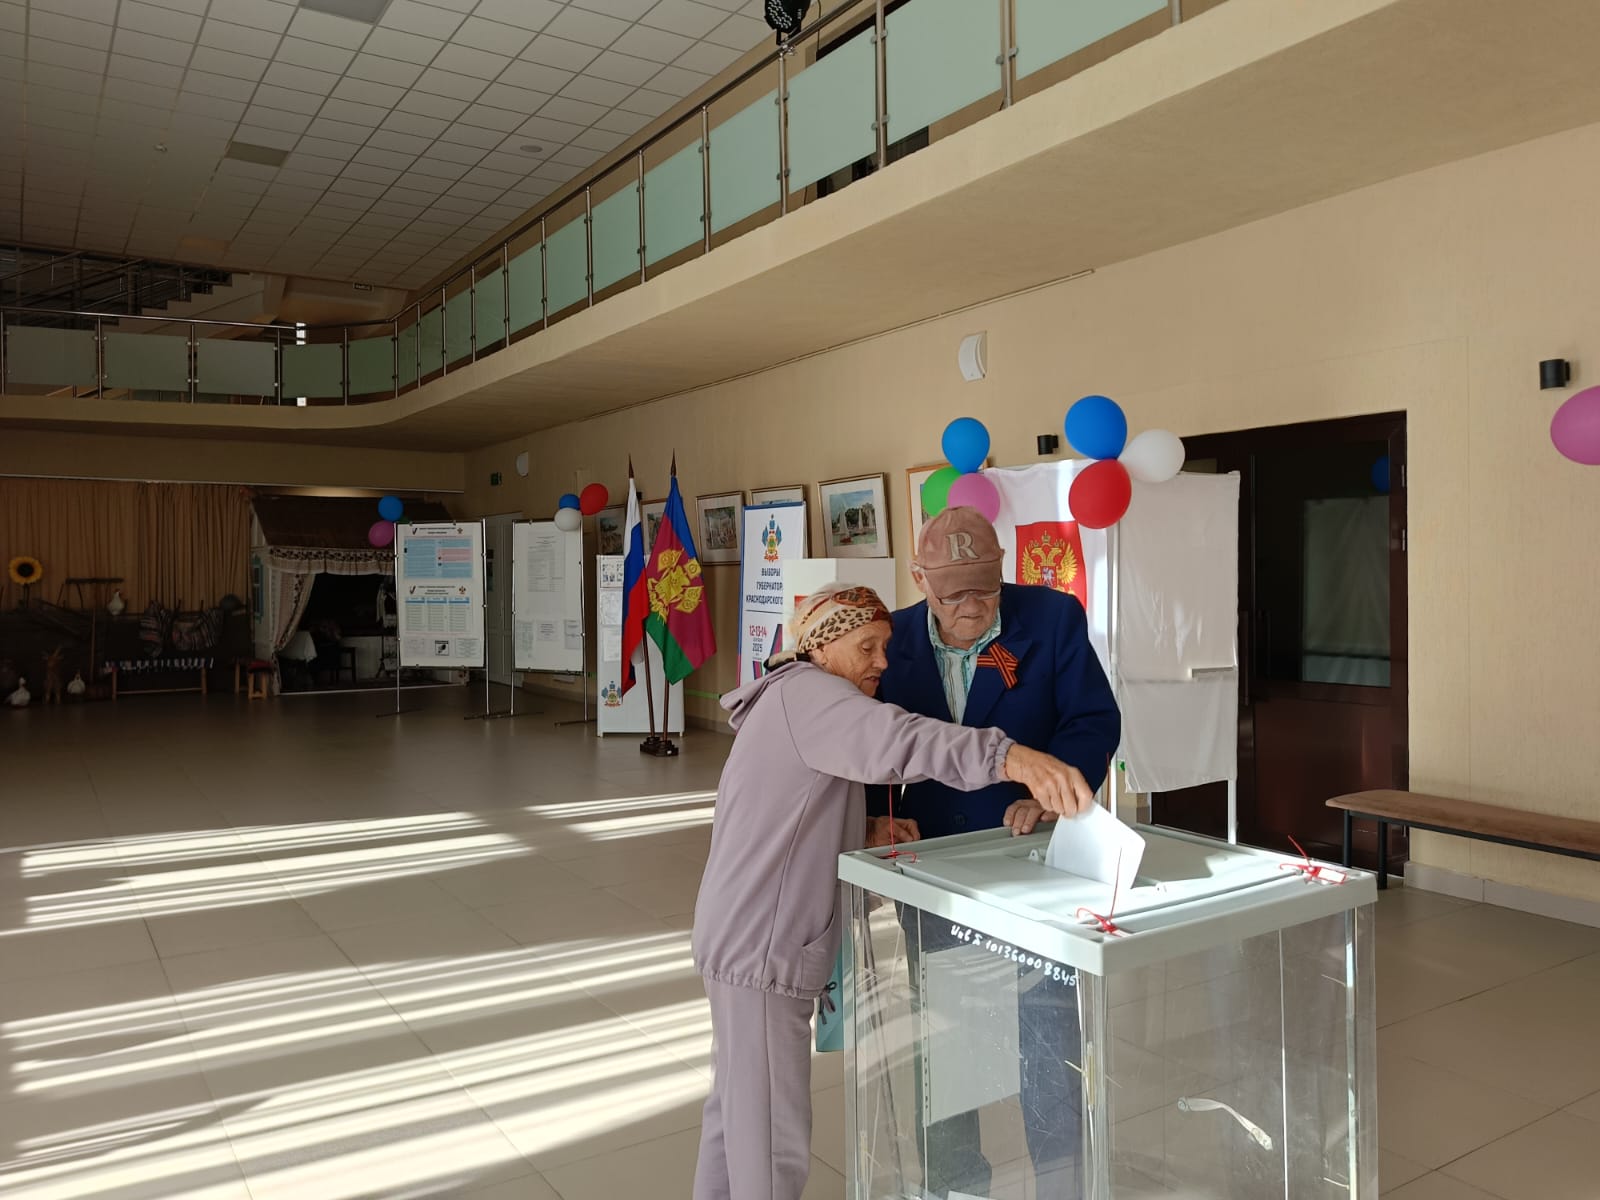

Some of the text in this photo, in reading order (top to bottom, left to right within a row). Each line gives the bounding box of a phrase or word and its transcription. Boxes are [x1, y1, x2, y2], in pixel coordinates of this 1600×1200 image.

[946, 532, 979, 561] R
[761, 568, 781, 577] ВЫБОРЫ
[756, 581, 784, 591] ГУБЕРНАТОР
